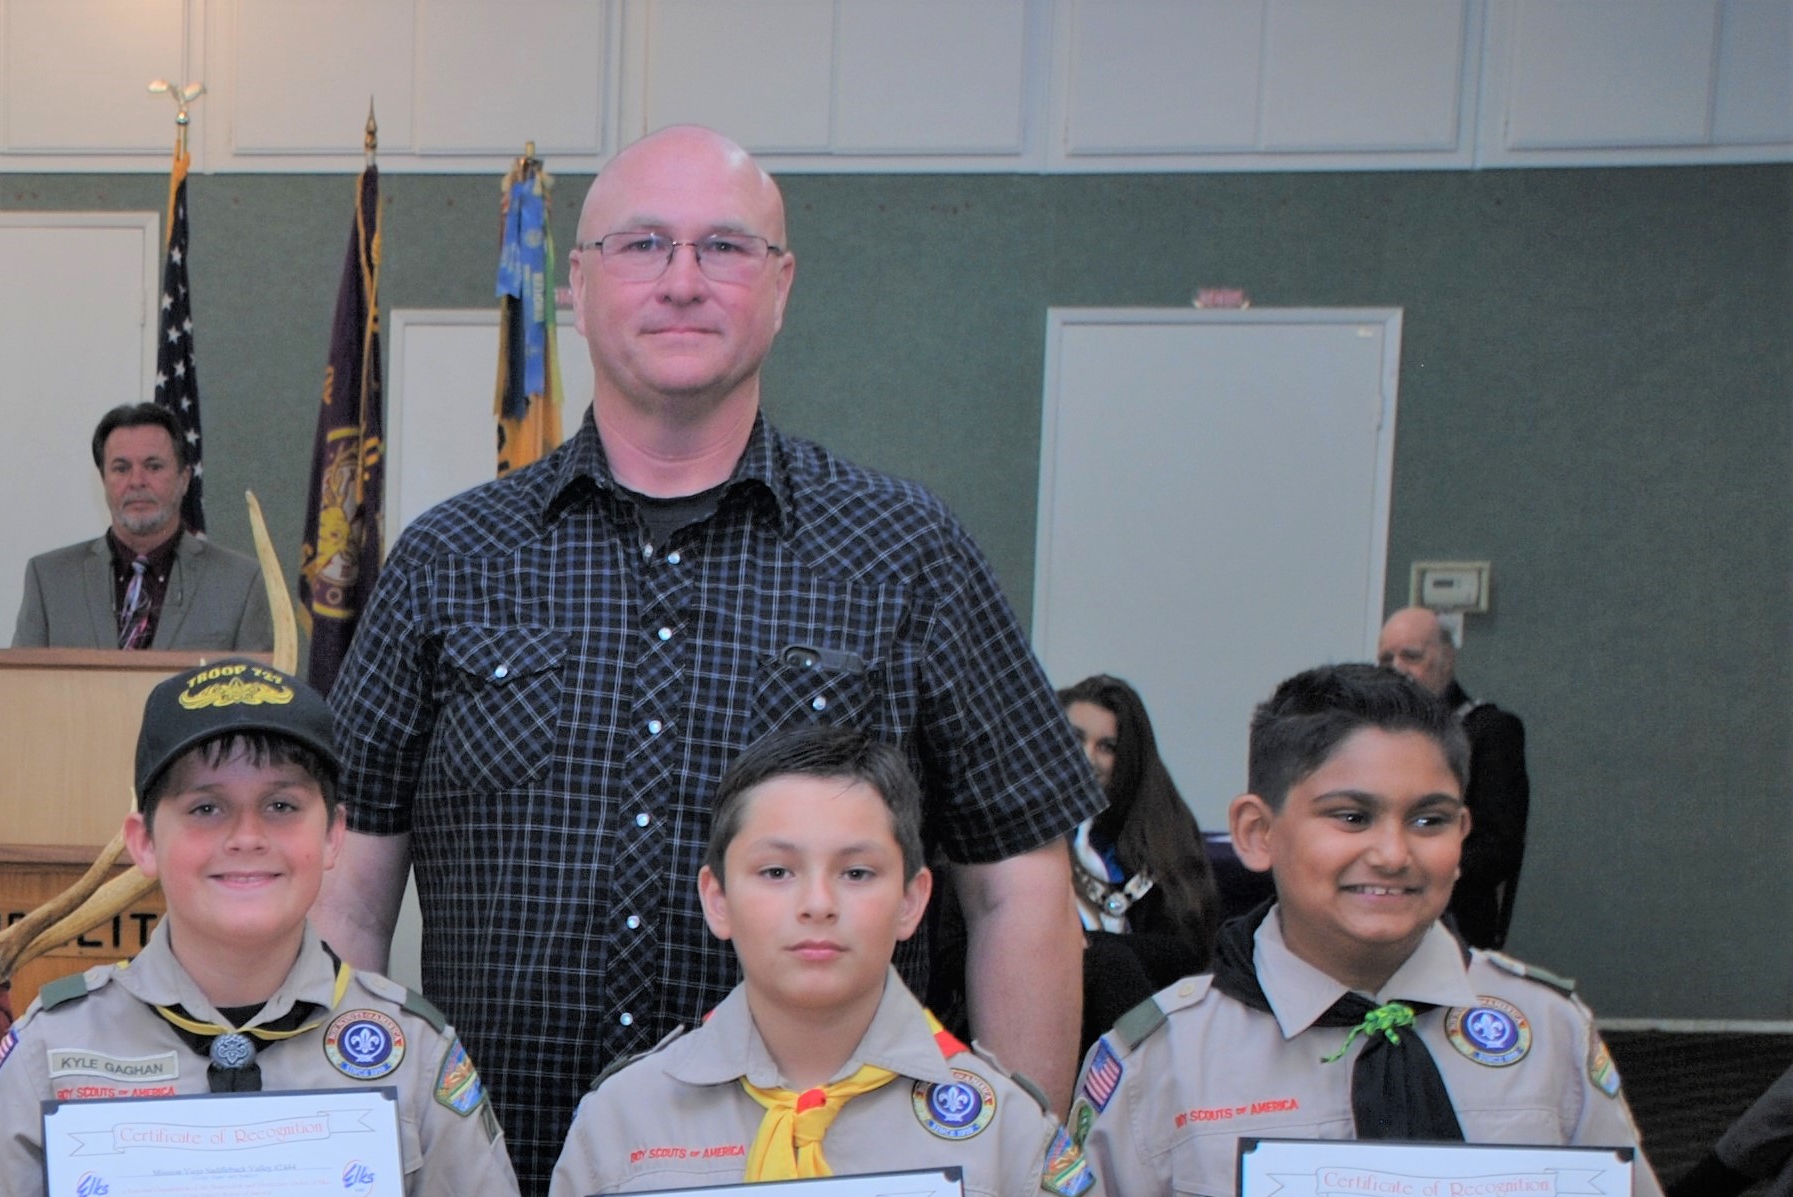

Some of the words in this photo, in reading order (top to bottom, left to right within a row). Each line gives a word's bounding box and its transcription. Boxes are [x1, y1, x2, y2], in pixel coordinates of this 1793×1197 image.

[187, 665, 247, 688] TROOP
[61, 1057, 98, 1069] KYLE
[104, 1062, 163, 1075] GAGHAN
[77, 1086, 115, 1098] SCOUTS
[132, 1086, 175, 1098] AMERICA
[1190, 1108, 1233, 1121] SCOUTS
[1251, 1098, 1299, 1115] AMERICA
[120, 1128, 202, 1144] Certificate
[210, 1129, 226, 1145] of
[234, 1122, 323, 1143] Recognition
[649, 1148, 686, 1159] SCOUTS
[703, 1145, 745, 1158] AMERICA
[343, 1164, 374, 1189] Elks
[1324, 1172, 1413, 1195] Certificate
[1423, 1181, 1441, 1197] of
